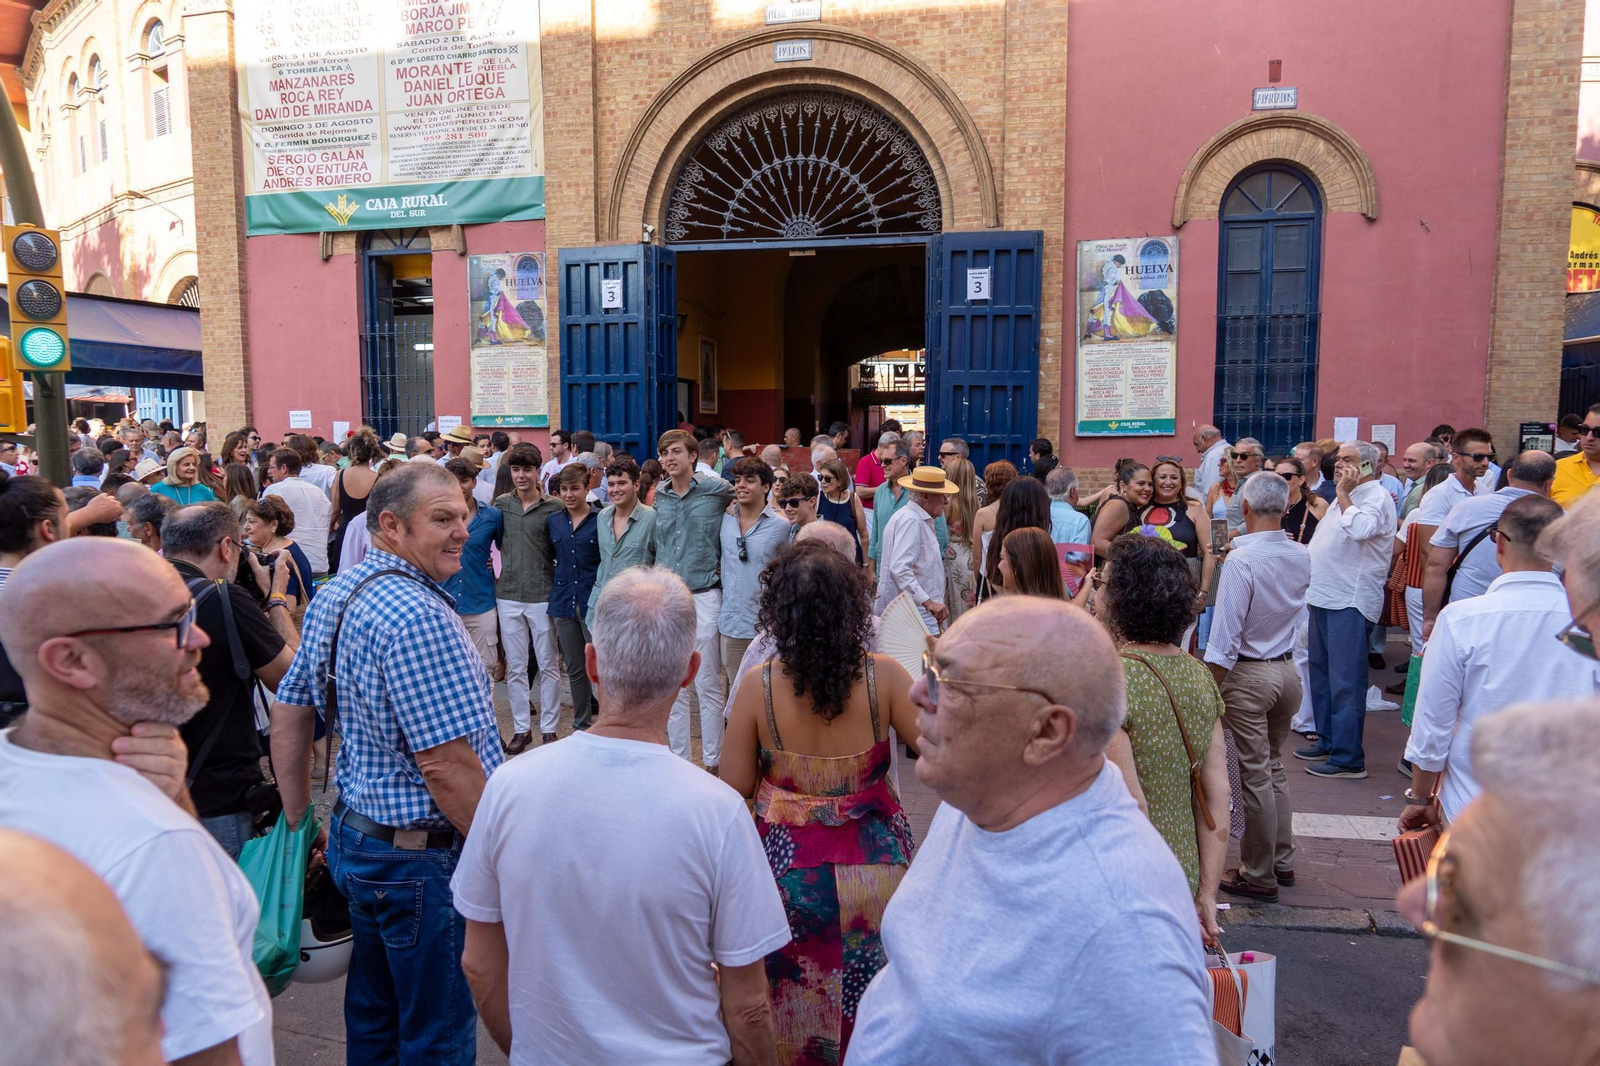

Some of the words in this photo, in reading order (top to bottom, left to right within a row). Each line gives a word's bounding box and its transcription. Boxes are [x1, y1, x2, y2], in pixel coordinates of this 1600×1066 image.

[401, 6, 445, 21] BORJA
[406, 19, 453, 35] MARCO
[325, 47, 367, 56] AGOSTO
[467, 40, 493, 49] Toros
[417, 54, 444, 62] LORETO
[287, 66, 342, 74] TORREALTA
[396, 61, 472, 79] MORANTE
[478, 63, 516, 71] PUEBLA
[269, 73, 355, 92] MANZANARES
[404, 78, 454, 92] DANIEL
[459, 72, 505, 88] LUQUE
[281, 90, 315, 104] ROCA
[318, 88, 344, 101] REY
[406, 93, 442, 107] JUAN
[447, 87, 505, 103] ORTEGA
[256, 107, 290, 120] DAVID
[293, 105, 310, 116] DE
[314, 100, 373, 115] MIRANDA
[261, 124, 304, 133] DOMINGO
[331, 118, 373, 127] AGOSTO
[394, 116, 524, 131] WWW.TOROSPEREDA.COM
[275, 138, 309, 147] FERMÍN
[268, 154, 316, 164] SERGIO
[321, 148, 364, 162] GALÁN
[267, 166, 304, 177] DIEGO
[308, 162, 368, 175] VENTURA
[316, 173, 371, 185] ROMERO
[366, 199, 398, 210] CAJA
[401, 194, 447, 208] RURAL
[1570, 251, 1598, 259] Andrés
[1126, 264, 1174, 275] HUELVA
[506, 278, 543, 286] HUELVA
[974, 282, 982, 293] 3
[608, 291, 615, 302] 3
